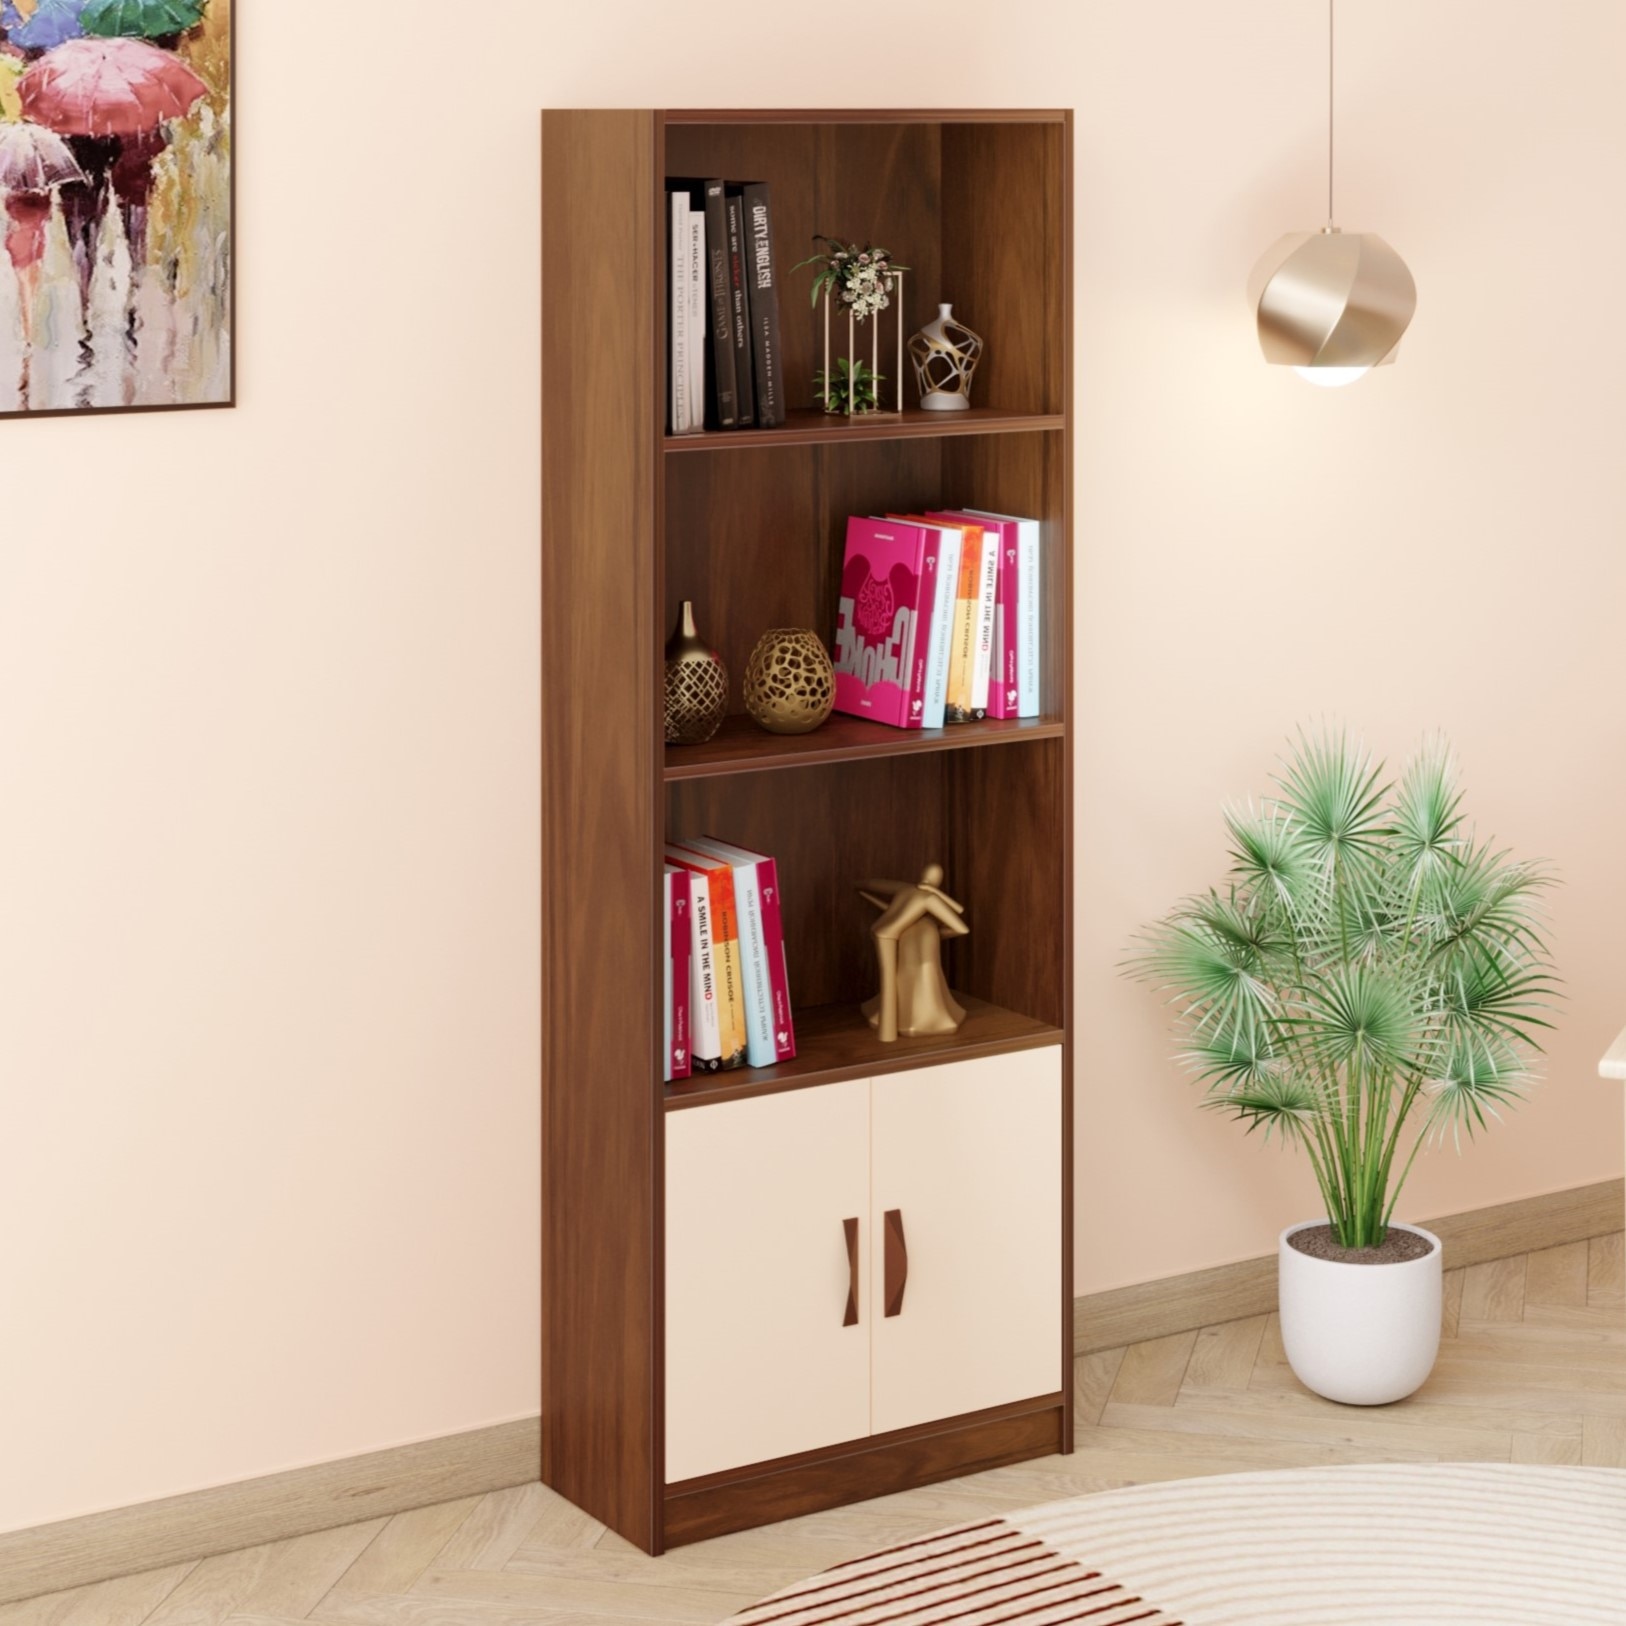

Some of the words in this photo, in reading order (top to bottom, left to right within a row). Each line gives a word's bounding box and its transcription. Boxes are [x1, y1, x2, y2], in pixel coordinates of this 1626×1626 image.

[752, 206, 768, 242] DIRTY
[730, 236, 738, 252] are
[677, 255, 685, 283] THE
[713, 249, 726, 298] THRONES
[754, 240, 772, 289] ENGLISH
[677, 286, 685, 338] PORTER
[734, 290, 742, 313] than
[716, 306, 728, 340] GAME
[736, 315, 744, 348] others
[677, 341, 685, 420] PRINCIPLES
[697, 896, 705, 904] A
[697, 906, 709, 936] SMILE
[700, 939, 709, 950] IN
[721, 911, 732, 963] ROBINSON
[727, 966, 735, 1003] CRUSOE
[702, 953, 710, 971] THE
[703, 973, 713, 1001] MIND
